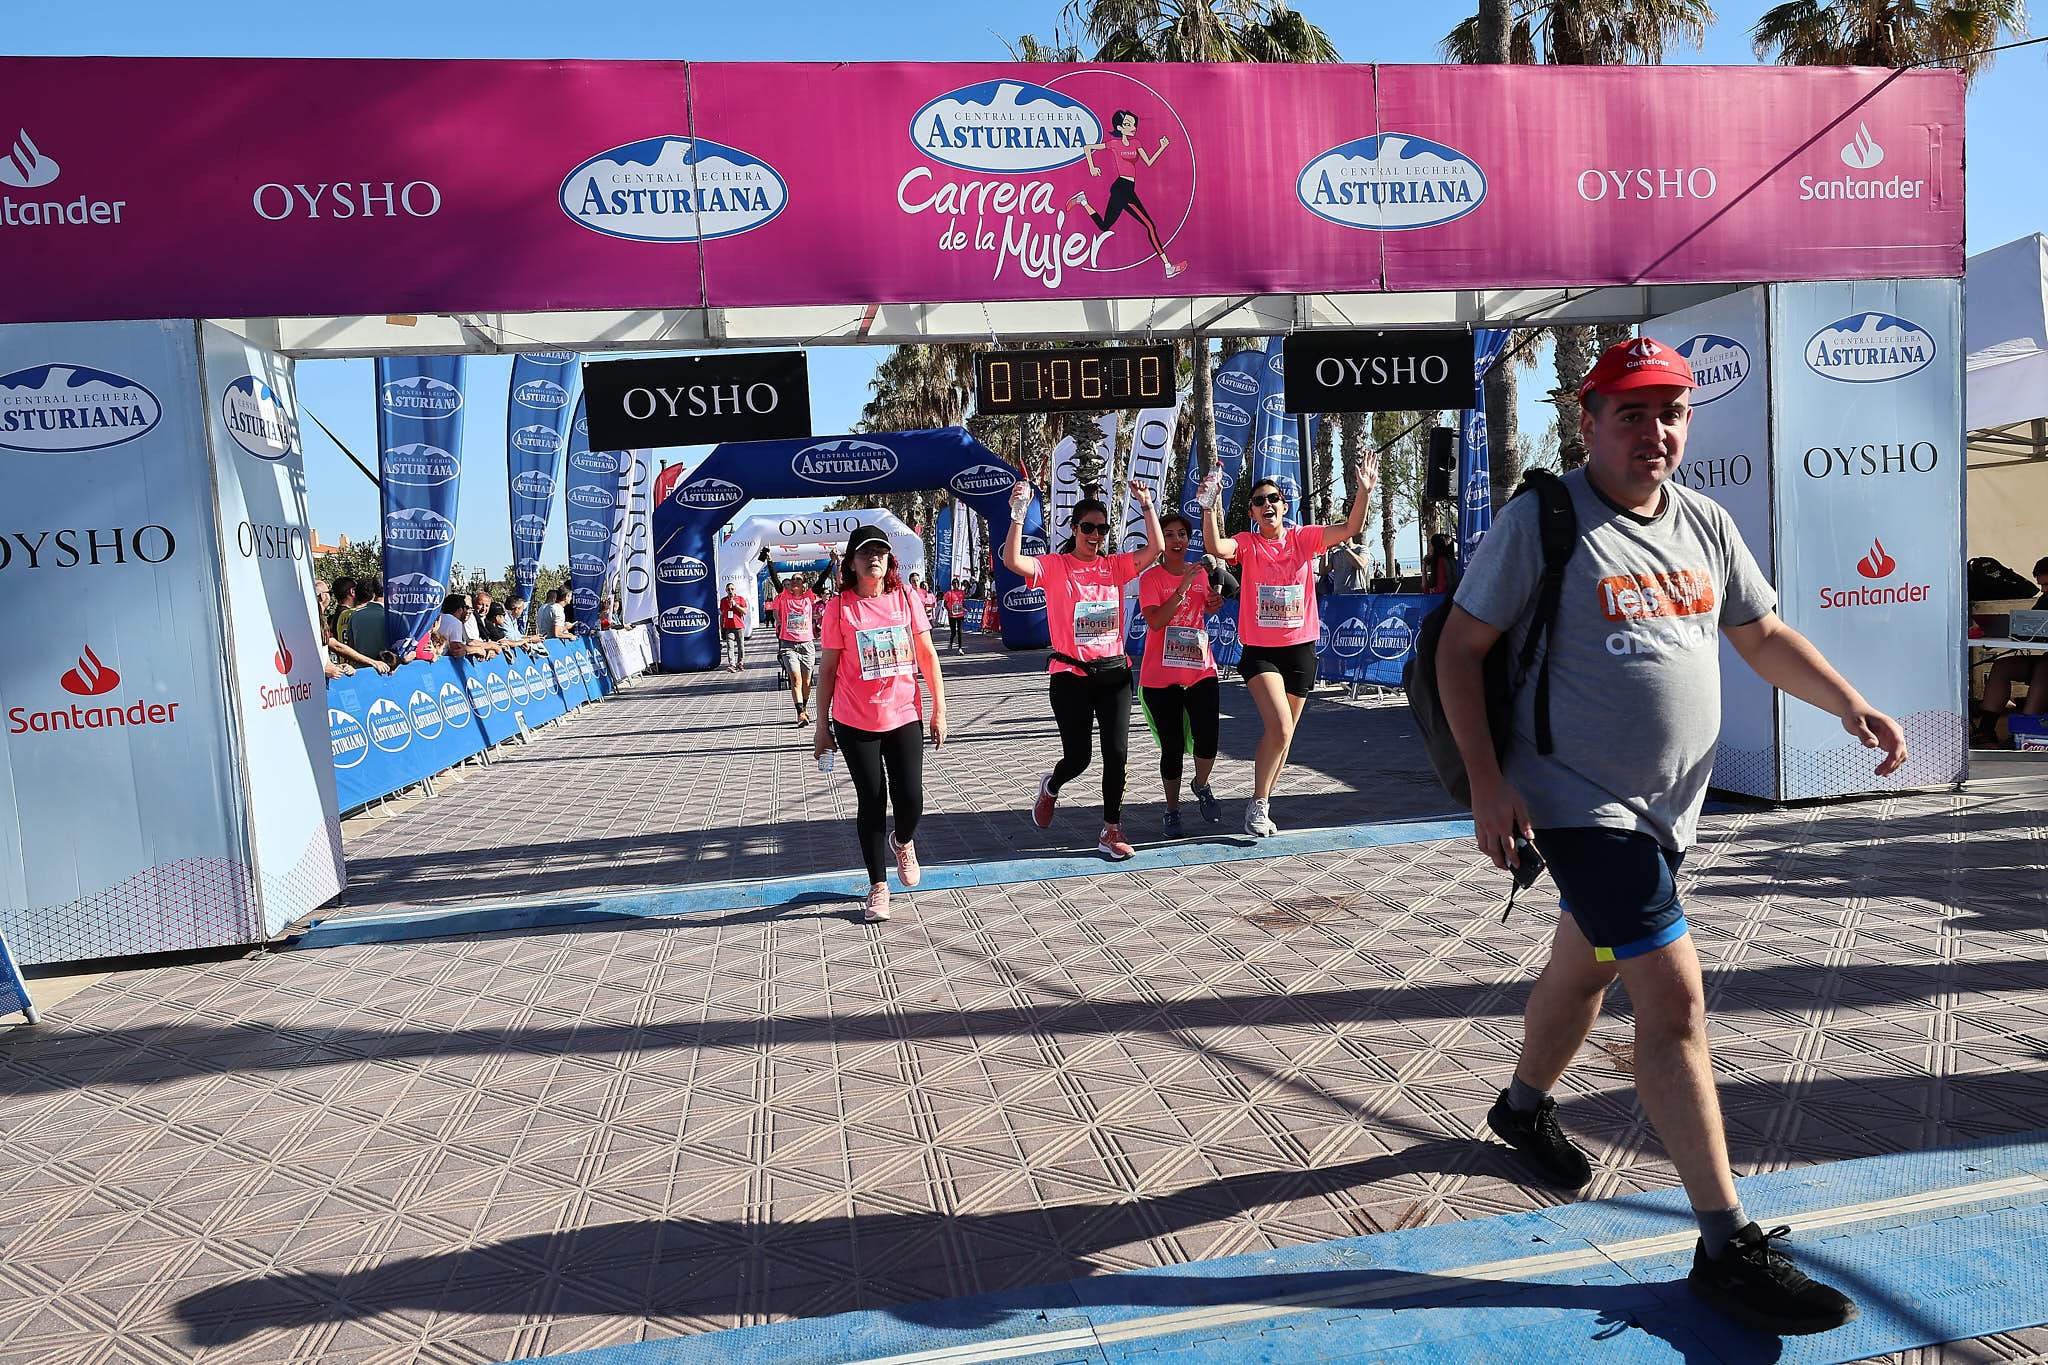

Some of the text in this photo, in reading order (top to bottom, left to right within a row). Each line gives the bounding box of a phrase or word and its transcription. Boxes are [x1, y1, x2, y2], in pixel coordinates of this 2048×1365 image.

[954, 112, 1081, 122] CENTRAL LECHERA
[926, 113, 1087, 149] ASTURIANA
[612, 173, 684, 184] CENTRAL
[1340, 165, 1467, 176] CENTRAL LECHERA
[578, 176, 772, 216] ASTURIANA
[896, 166, 1056, 215] Carrera
[1311, 169, 1474, 206] ASTURIANA
[1577, 167, 1717, 201] OYSHO
[1799, 175, 1924, 201] Santander
[0, 194, 126, 226] tander
[252, 180, 442, 220] OYSHO
[938, 209, 1115, 289] de la Mujer
[1833, 335, 1922, 345] CENTRAL LECHERA
[1626, 357, 1670, 368] Carrefour
[1813, 340, 1926, 367] ASTURIANA
[990, 356, 1160, 402] 01:06:10
[1315, 354, 1449, 388] OYSHO
[6, 391, 139, 406] CENTRAL LECHERA
[383, 389, 457, 410] ASTURIANA
[622, 382, 779, 420] OYSHO
[229, 397, 290, 445] ASTURIANA
[1214, 409, 1248, 424] STURIANA
[383, 457, 454, 476] ASTURIANA
[574, 455, 615, 471] ASTURIANA
[800, 455, 892, 475] ASTURIANA
[1671, 454, 1752, 490] YSHO
[1803, 441, 1938, 479] OYSHO
[956, 475, 1013, 490] ASTURIANA
[570, 491, 611, 505] ASTURIANA
[680, 491, 738, 503] ASTURIANA
[778, 516, 861, 537] OYSHO
[237, 521, 304, 561] OYSHO
[730, 540, 756, 548] OYSHO
[658, 566, 705, 579] ASTURIANA
[1604, 583, 1660, 616] les
[1820, 582, 1931, 610] Santander
[661, 616, 707, 629] ASTURIANA
[1371, 631, 1409, 649] ASTURIANA
[259, 679, 313, 711] Santander
[8, 699, 180, 735] Santander
[370, 720, 411, 743] ASTURIANA
[332, 732, 367, 757] STURIANA
